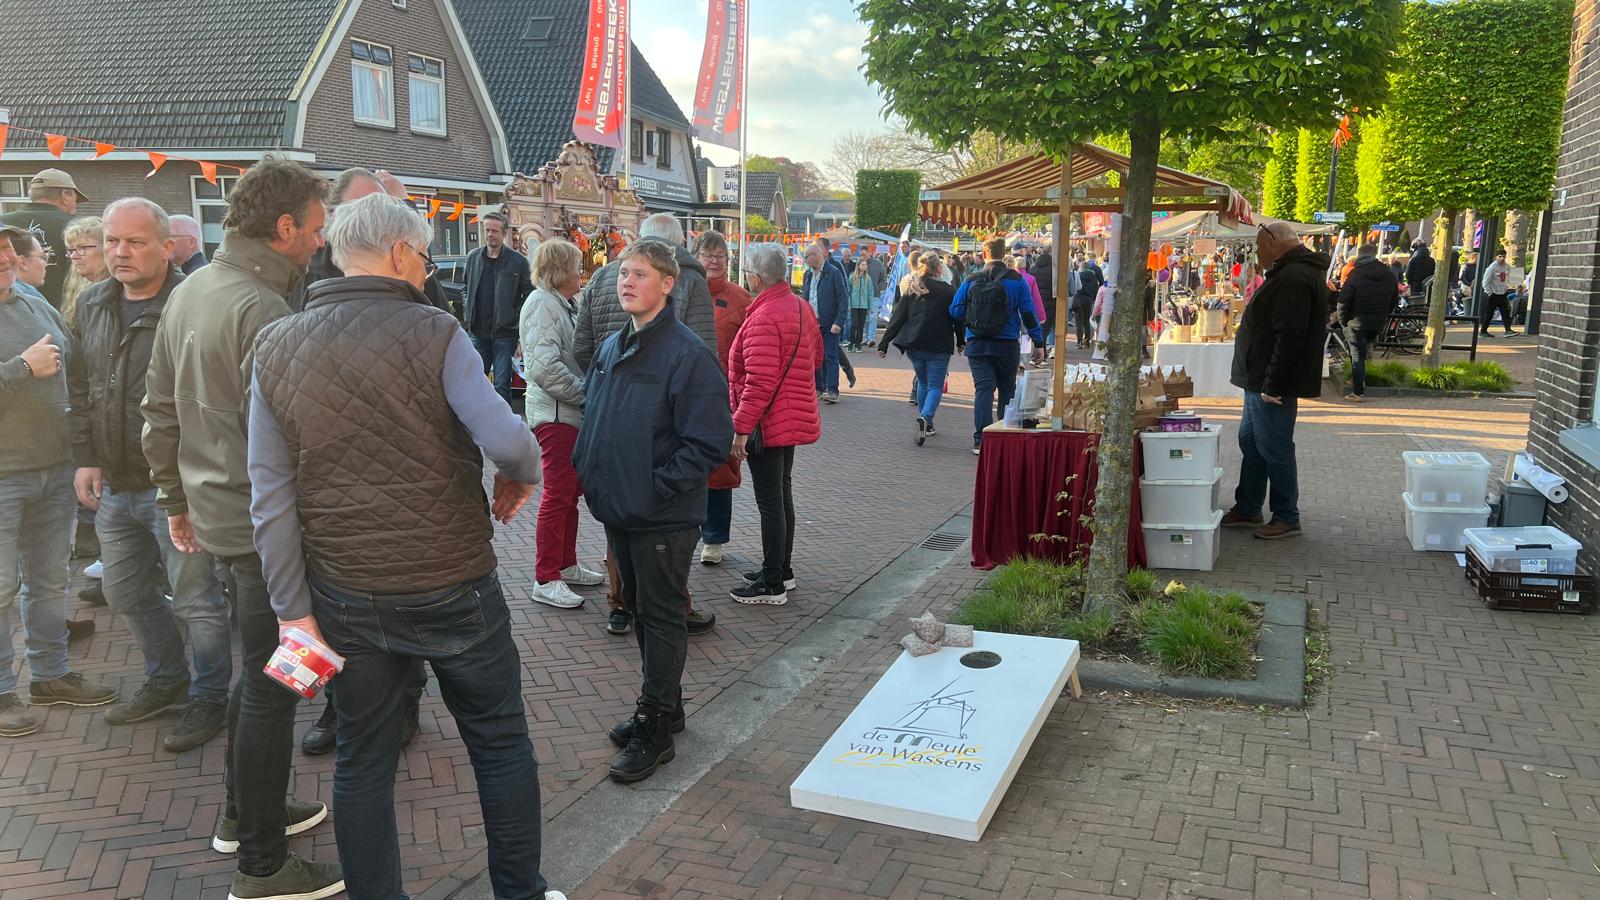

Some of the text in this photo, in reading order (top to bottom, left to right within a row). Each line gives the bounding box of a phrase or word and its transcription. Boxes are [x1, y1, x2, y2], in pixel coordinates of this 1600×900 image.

[632, 175, 658, 191] ESTERBEEK
[862, 729, 889, 741] de
[850, 742, 983, 772] van Wassens
